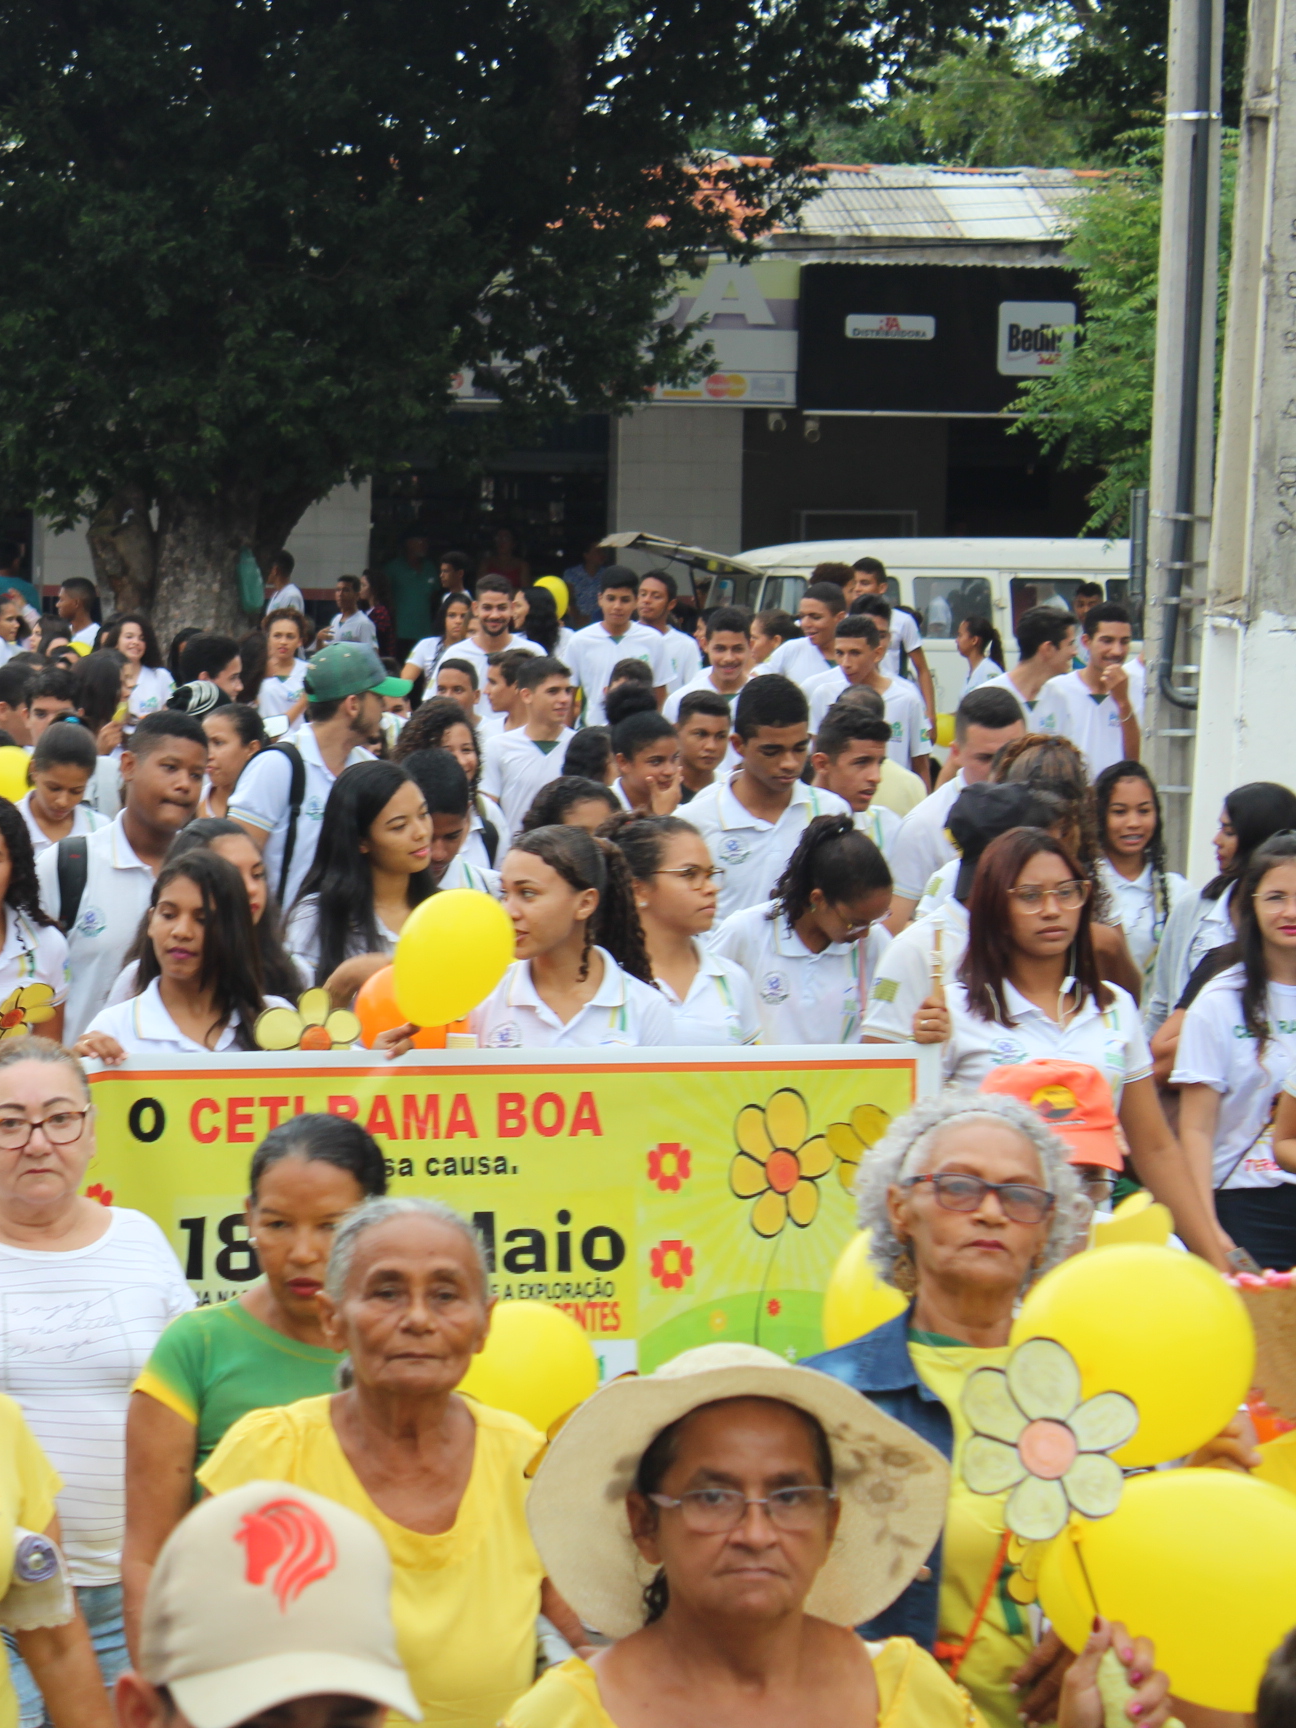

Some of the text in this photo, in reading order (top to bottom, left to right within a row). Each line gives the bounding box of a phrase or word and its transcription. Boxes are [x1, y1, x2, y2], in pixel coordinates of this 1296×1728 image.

[852, 328, 927, 338] DISTRIBUIDORA
[128, 1097, 166, 1143] O
[497, 1091, 603, 1138] BOA
[384, 1154, 519, 1178] sa causa.
[503, 1284, 514, 1300] A
[518, 1277, 615, 1302] EXPLORAÇÃO
